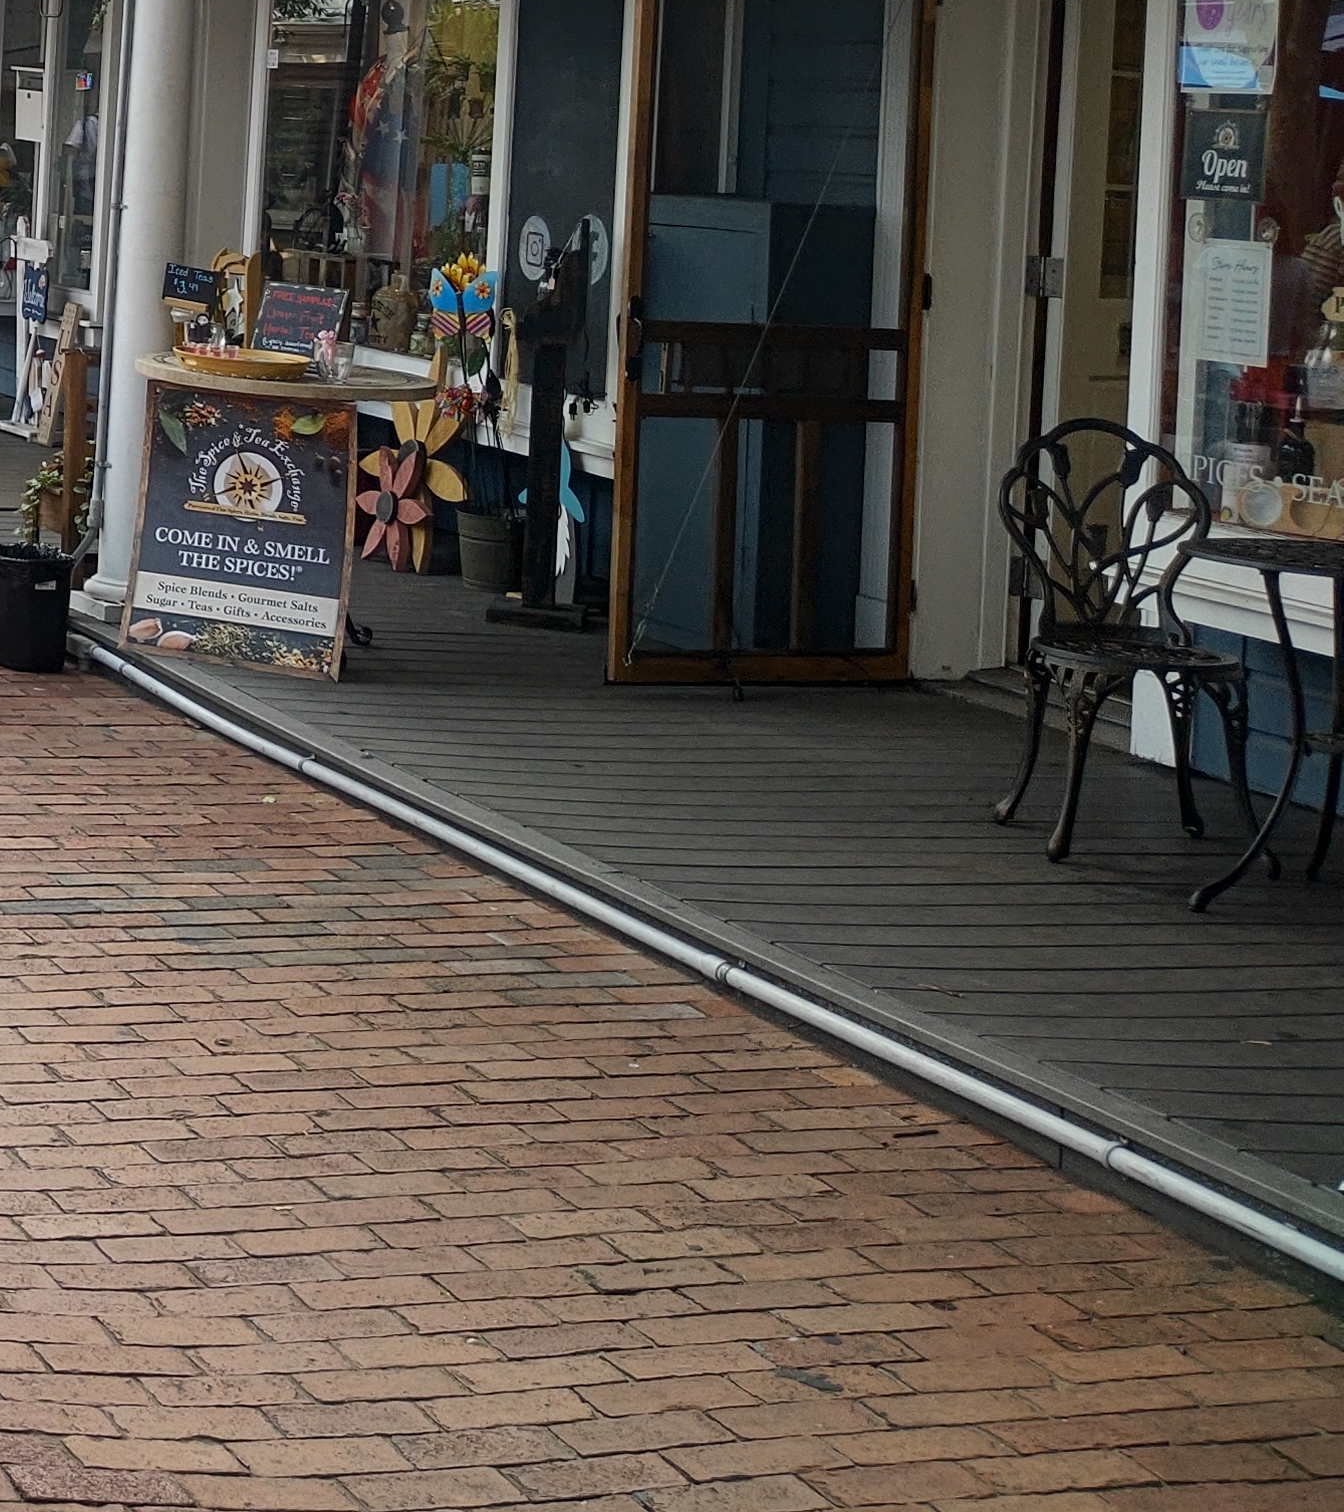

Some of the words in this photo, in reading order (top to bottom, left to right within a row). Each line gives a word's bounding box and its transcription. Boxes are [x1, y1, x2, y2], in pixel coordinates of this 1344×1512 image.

[1201, 149, 1248, 184] Open
[168, 263, 189, 278] Iced
[194, 270, 214, 284] Teas
[195, 436, 230, 467] Spice
[243, 427, 271, 448] Tea
[188, 469, 208, 494] The
[1185, 453, 1263, 492] PICES
[155, 526, 213, 549] COME
[216, 534, 241, 552] IN
[243, 538, 260, 555] &
[263, 541, 330, 565] SMELL
[178, 550, 221, 571] THE
[146, 594, 178, 609] Sugar
[188, 599, 213, 612] Teas
[223, 604, 251, 618] Gifts
[261, 611, 327, 629] Accessories
[158, 581, 187, 595] Spice
[190, 585, 228, 600] Blends
[238, 592, 287, 609] Gourmet
[290, 599, 318, 613] Salts
